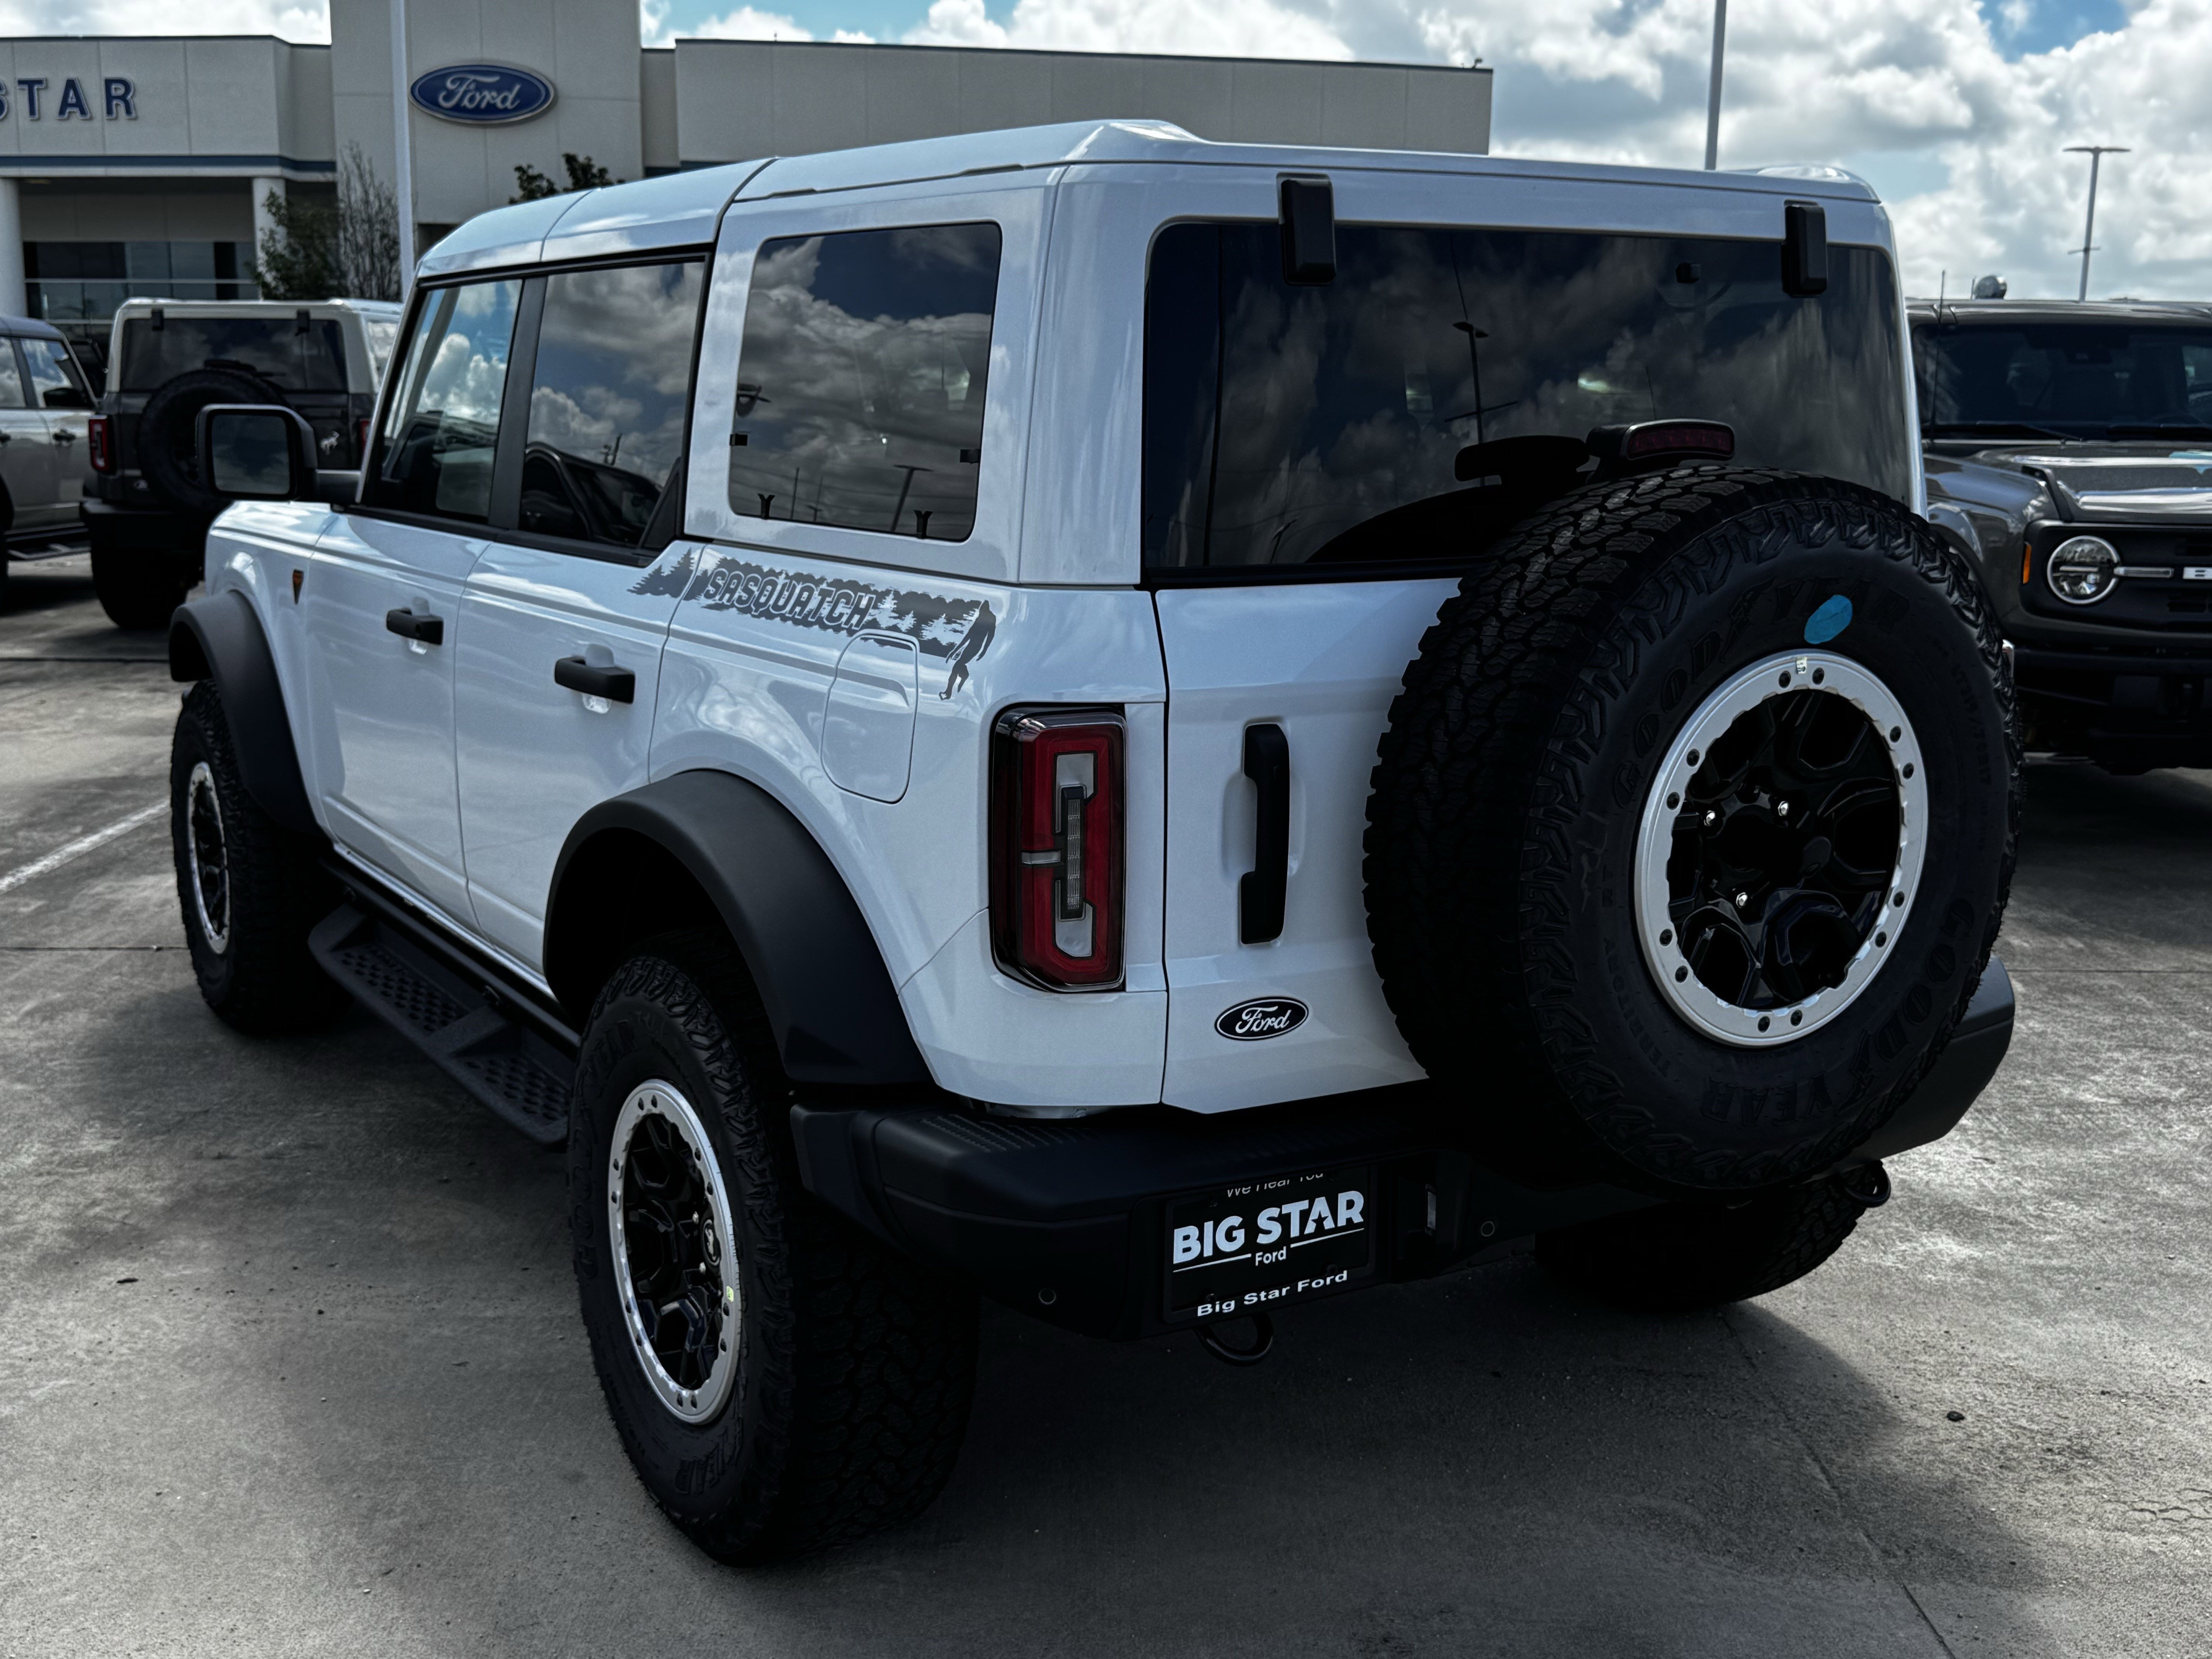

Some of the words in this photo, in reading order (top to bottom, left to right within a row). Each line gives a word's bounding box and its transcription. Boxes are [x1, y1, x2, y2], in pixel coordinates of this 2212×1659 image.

[0, 77, 136, 119] TAR
[438, 73, 521, 110] Ford
[704, 568, 876, 631] SASQUATCH
[1235, 1006, 1292, 1034] Ford
[1173, 1215, 1245, 1264] BIG
[1256, 1190, 1364, 1244] STAR
[1255, 1246, 1287, 1266] Ford
[1197, 1300, 1236, 1317] Big
[1243, 1286, 1290, 1305] Star
[1297, 1270, 1347, 1292] Ford
